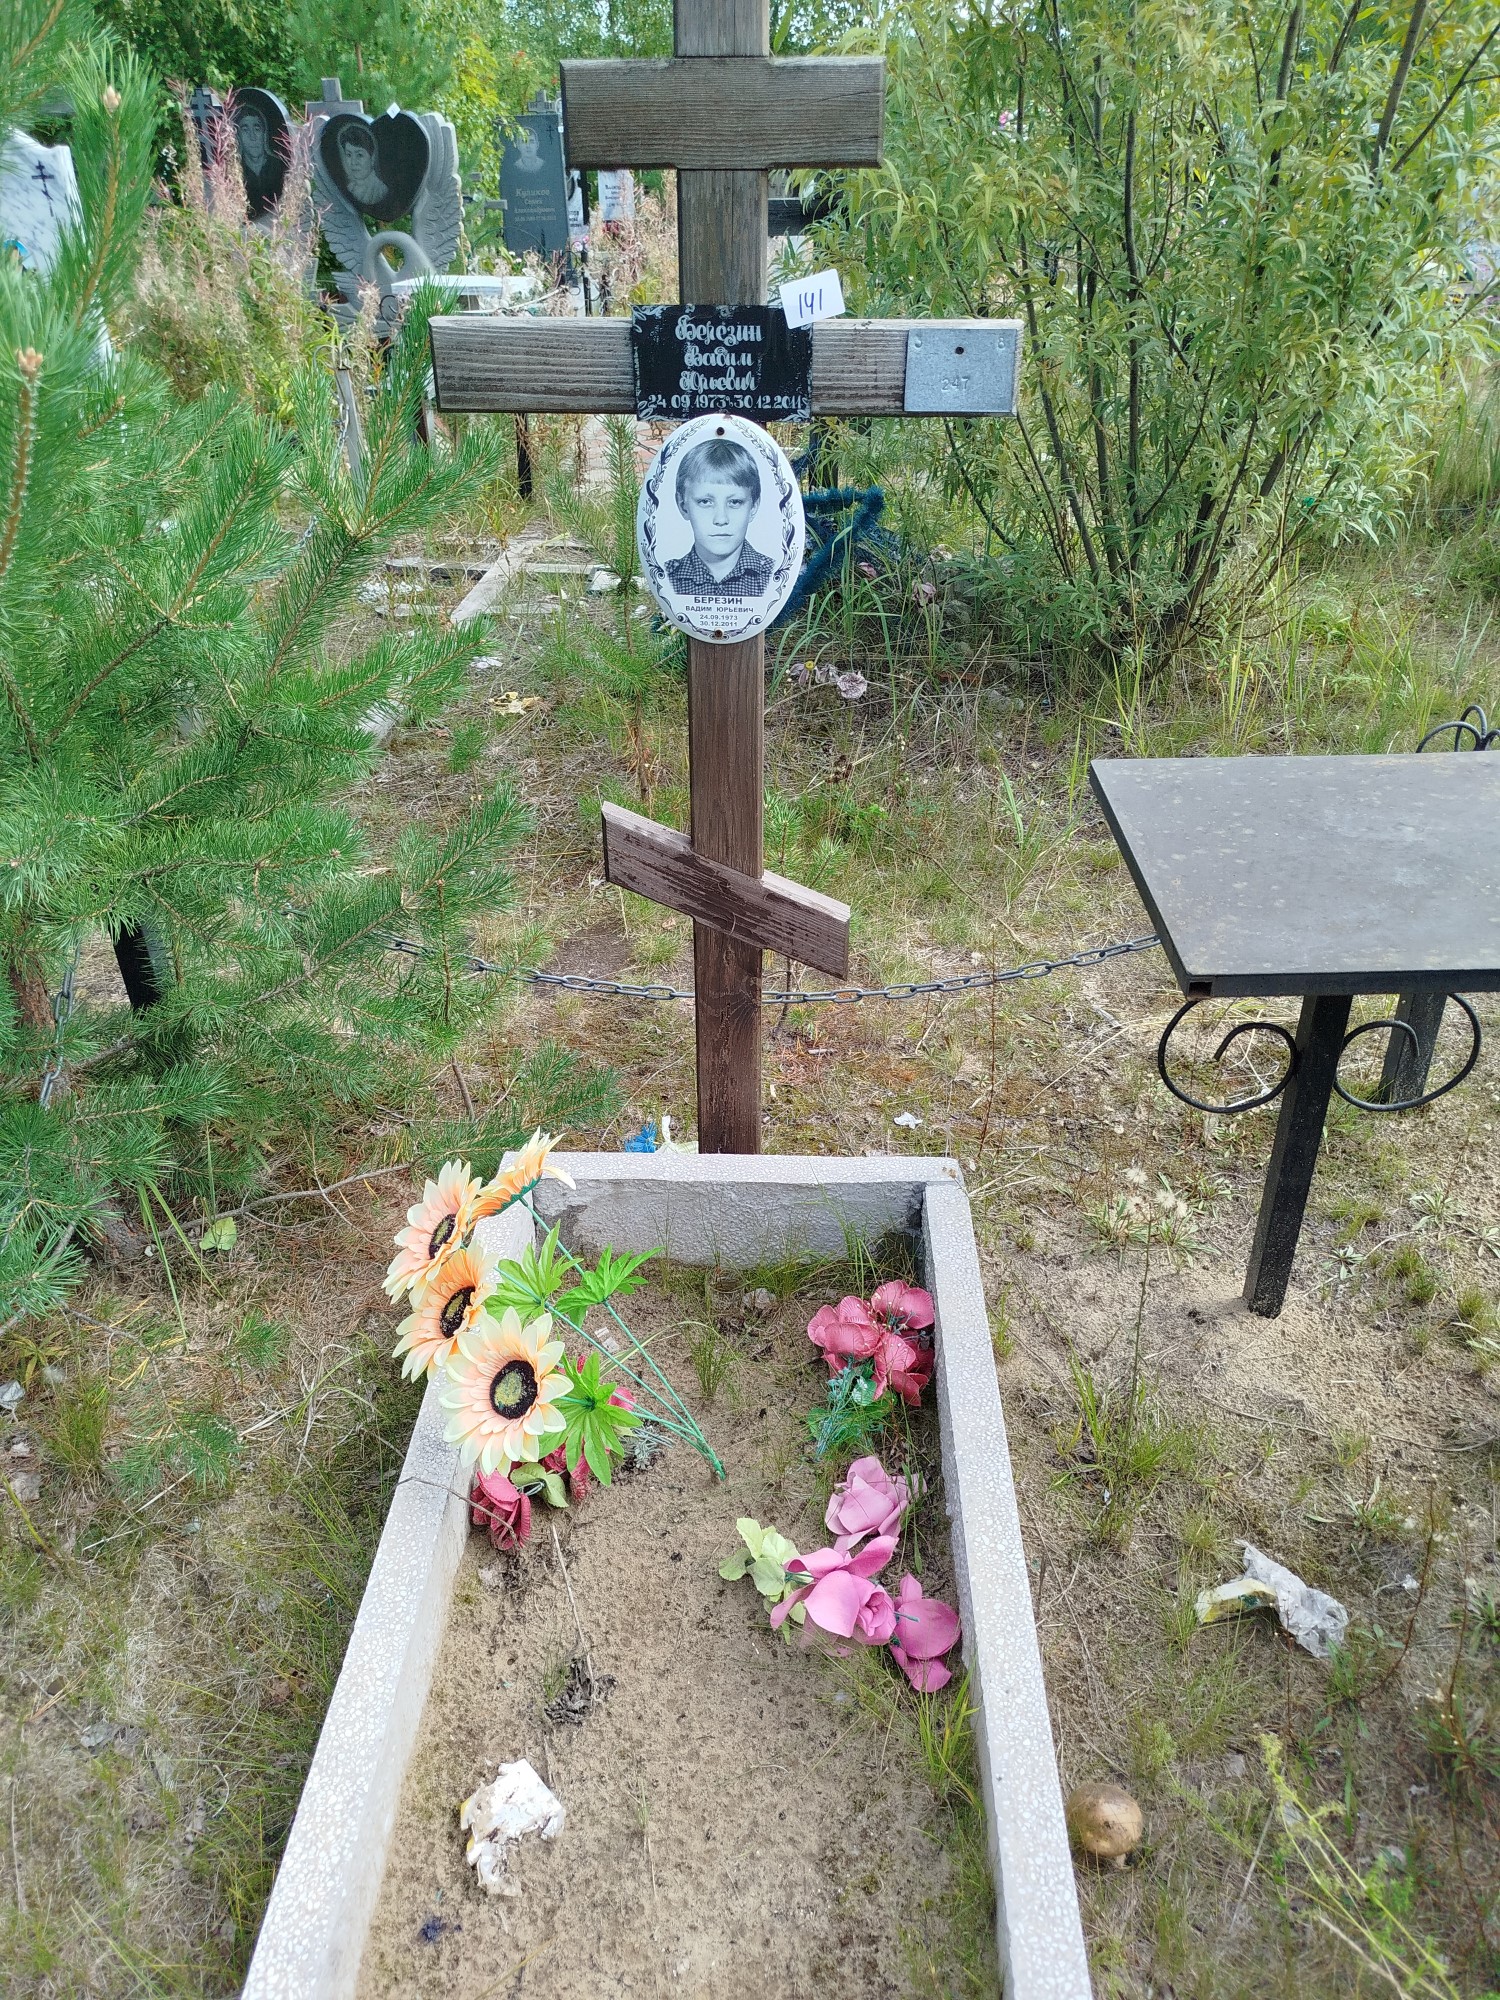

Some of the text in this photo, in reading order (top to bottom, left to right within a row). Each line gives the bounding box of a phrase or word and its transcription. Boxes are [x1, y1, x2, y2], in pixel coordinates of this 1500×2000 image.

[799, 288, 823, 319] 141
[675, 314, 765, 347] Березин
[684, 344, 755, 367] Вадим
[679, 366, 759, 394] Юрьевич
[940, 375, 971, 393] 247
[694, 596, 743, 605] БЕРЕЗИН
